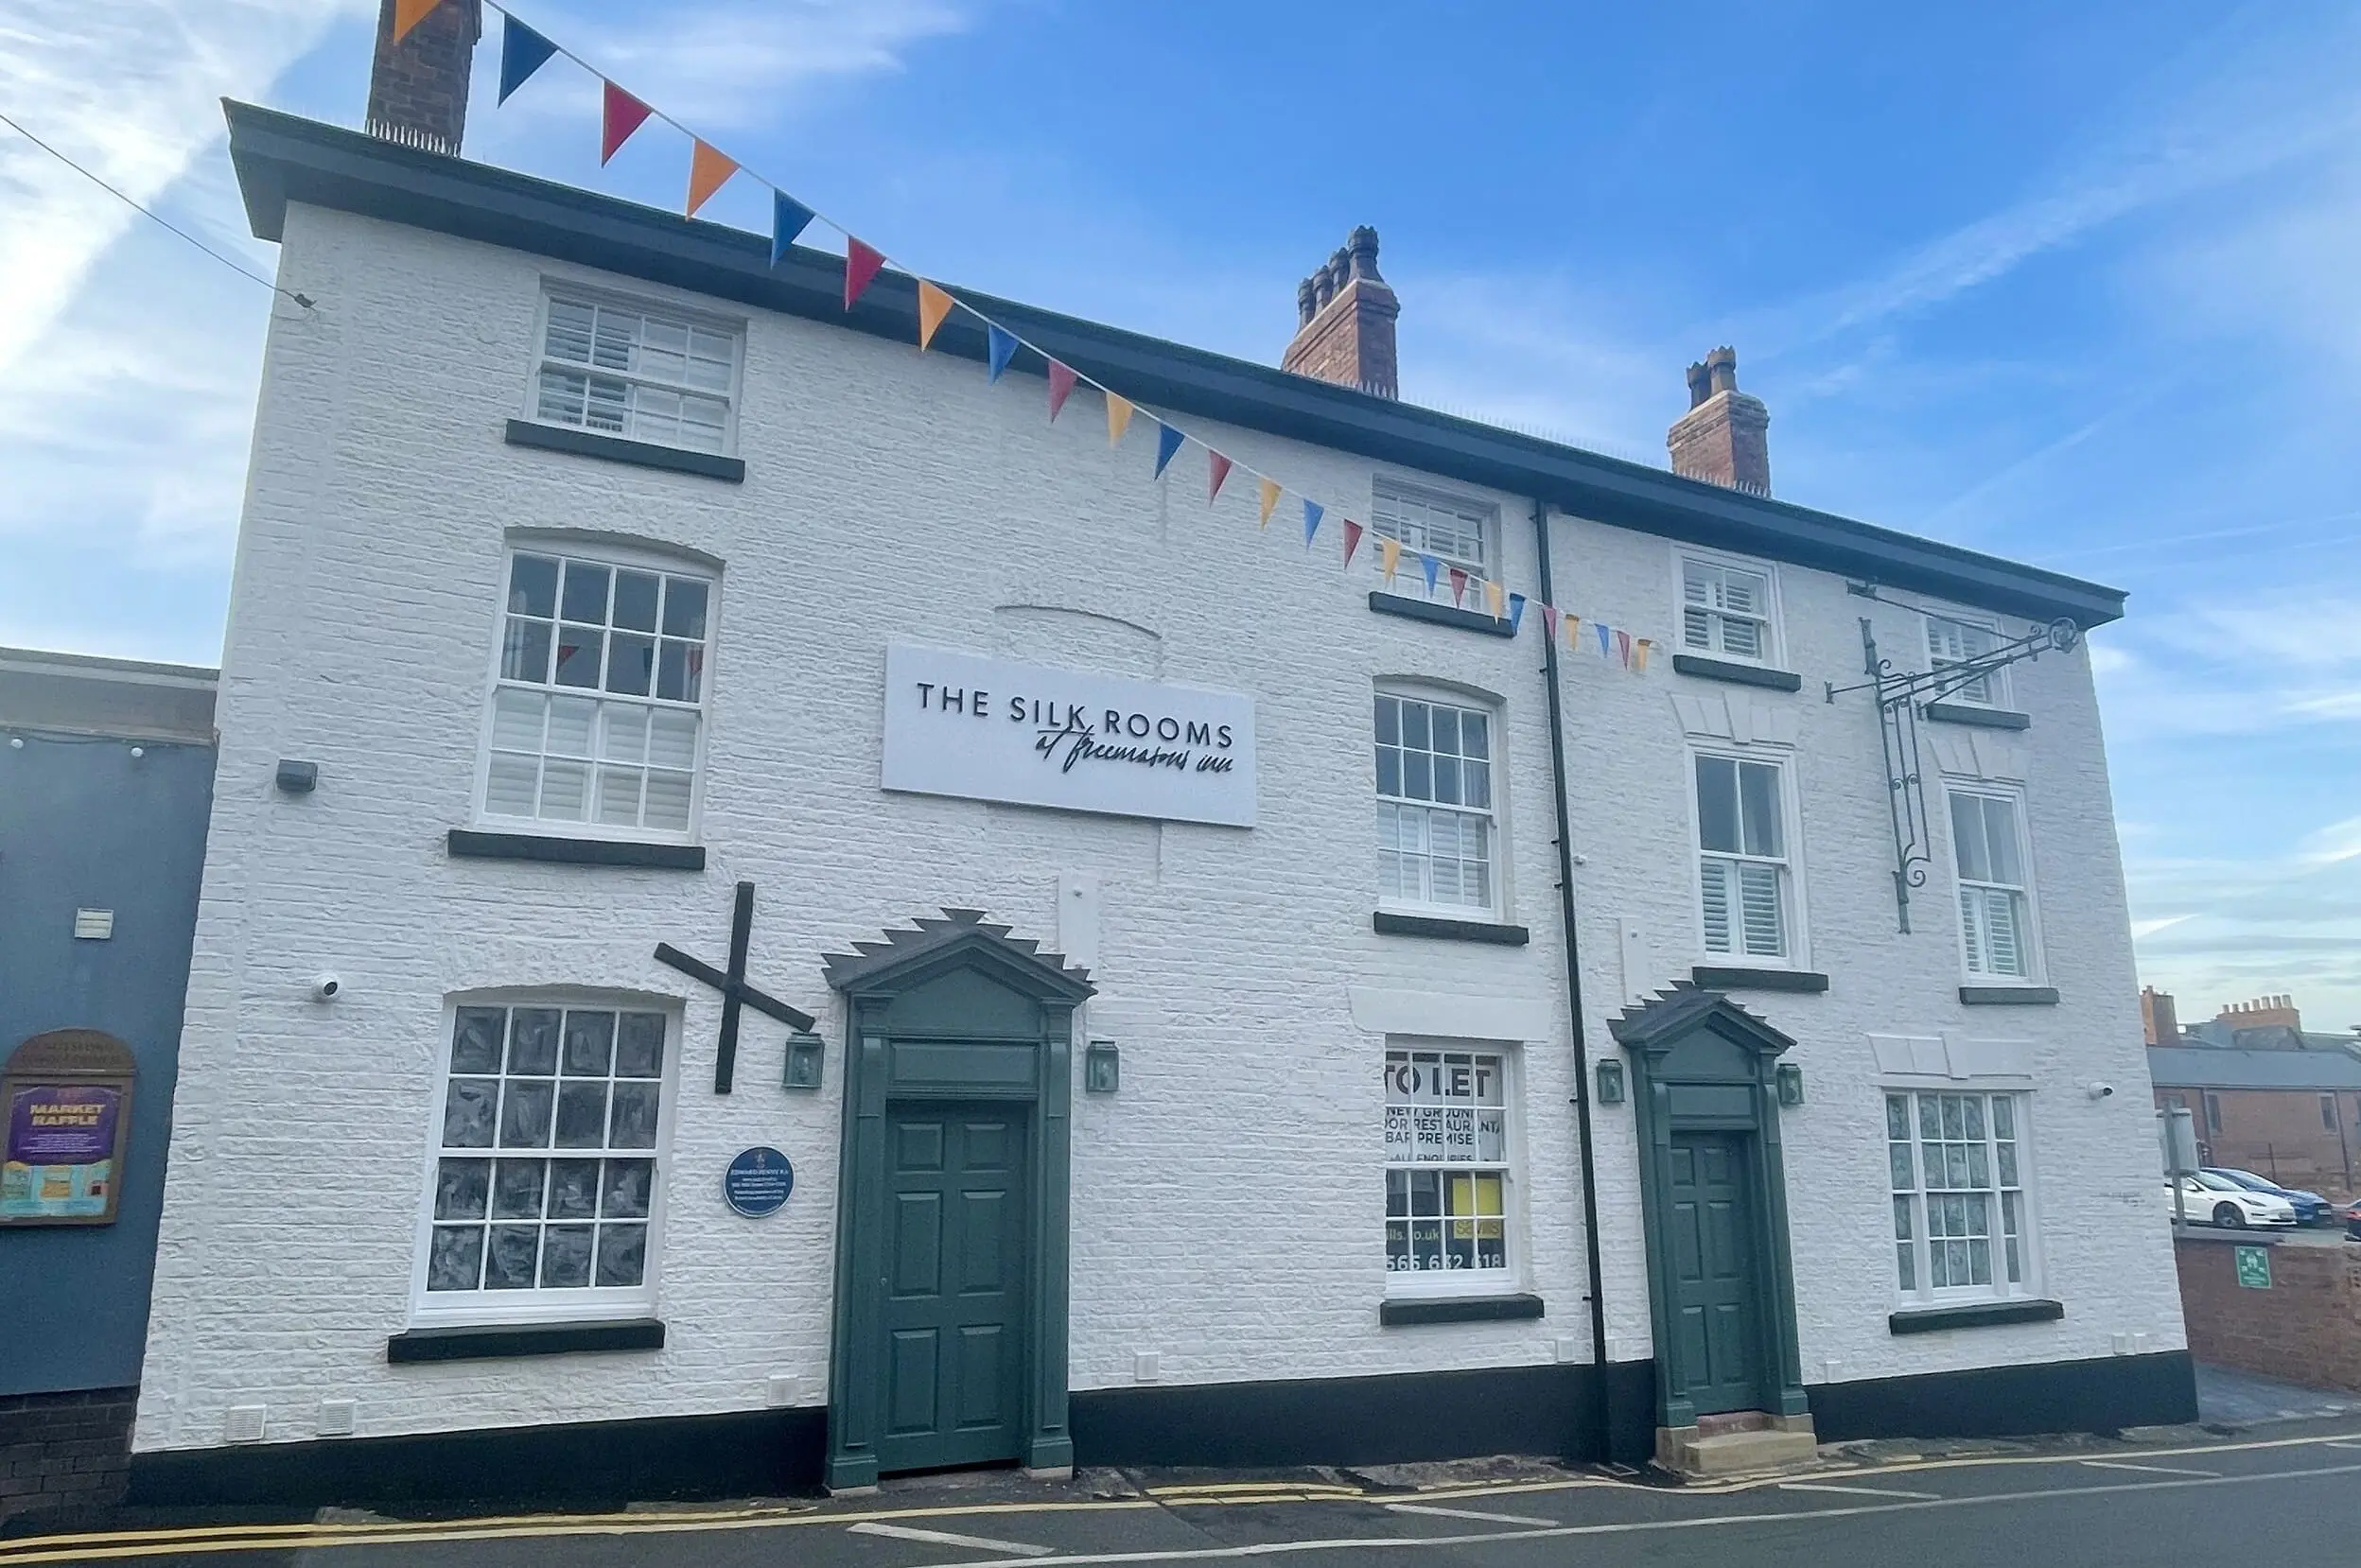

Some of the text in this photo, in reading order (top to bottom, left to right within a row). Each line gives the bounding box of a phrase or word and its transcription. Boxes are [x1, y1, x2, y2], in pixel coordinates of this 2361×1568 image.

[917, 682, 1233, 748] THE SILK ROOMS
[1384, 1065, 1491, 1097] TO LET
[30, 1105, 106, 1115] MARKET
[1417, 1132, 1480, 1145] PREMISE
